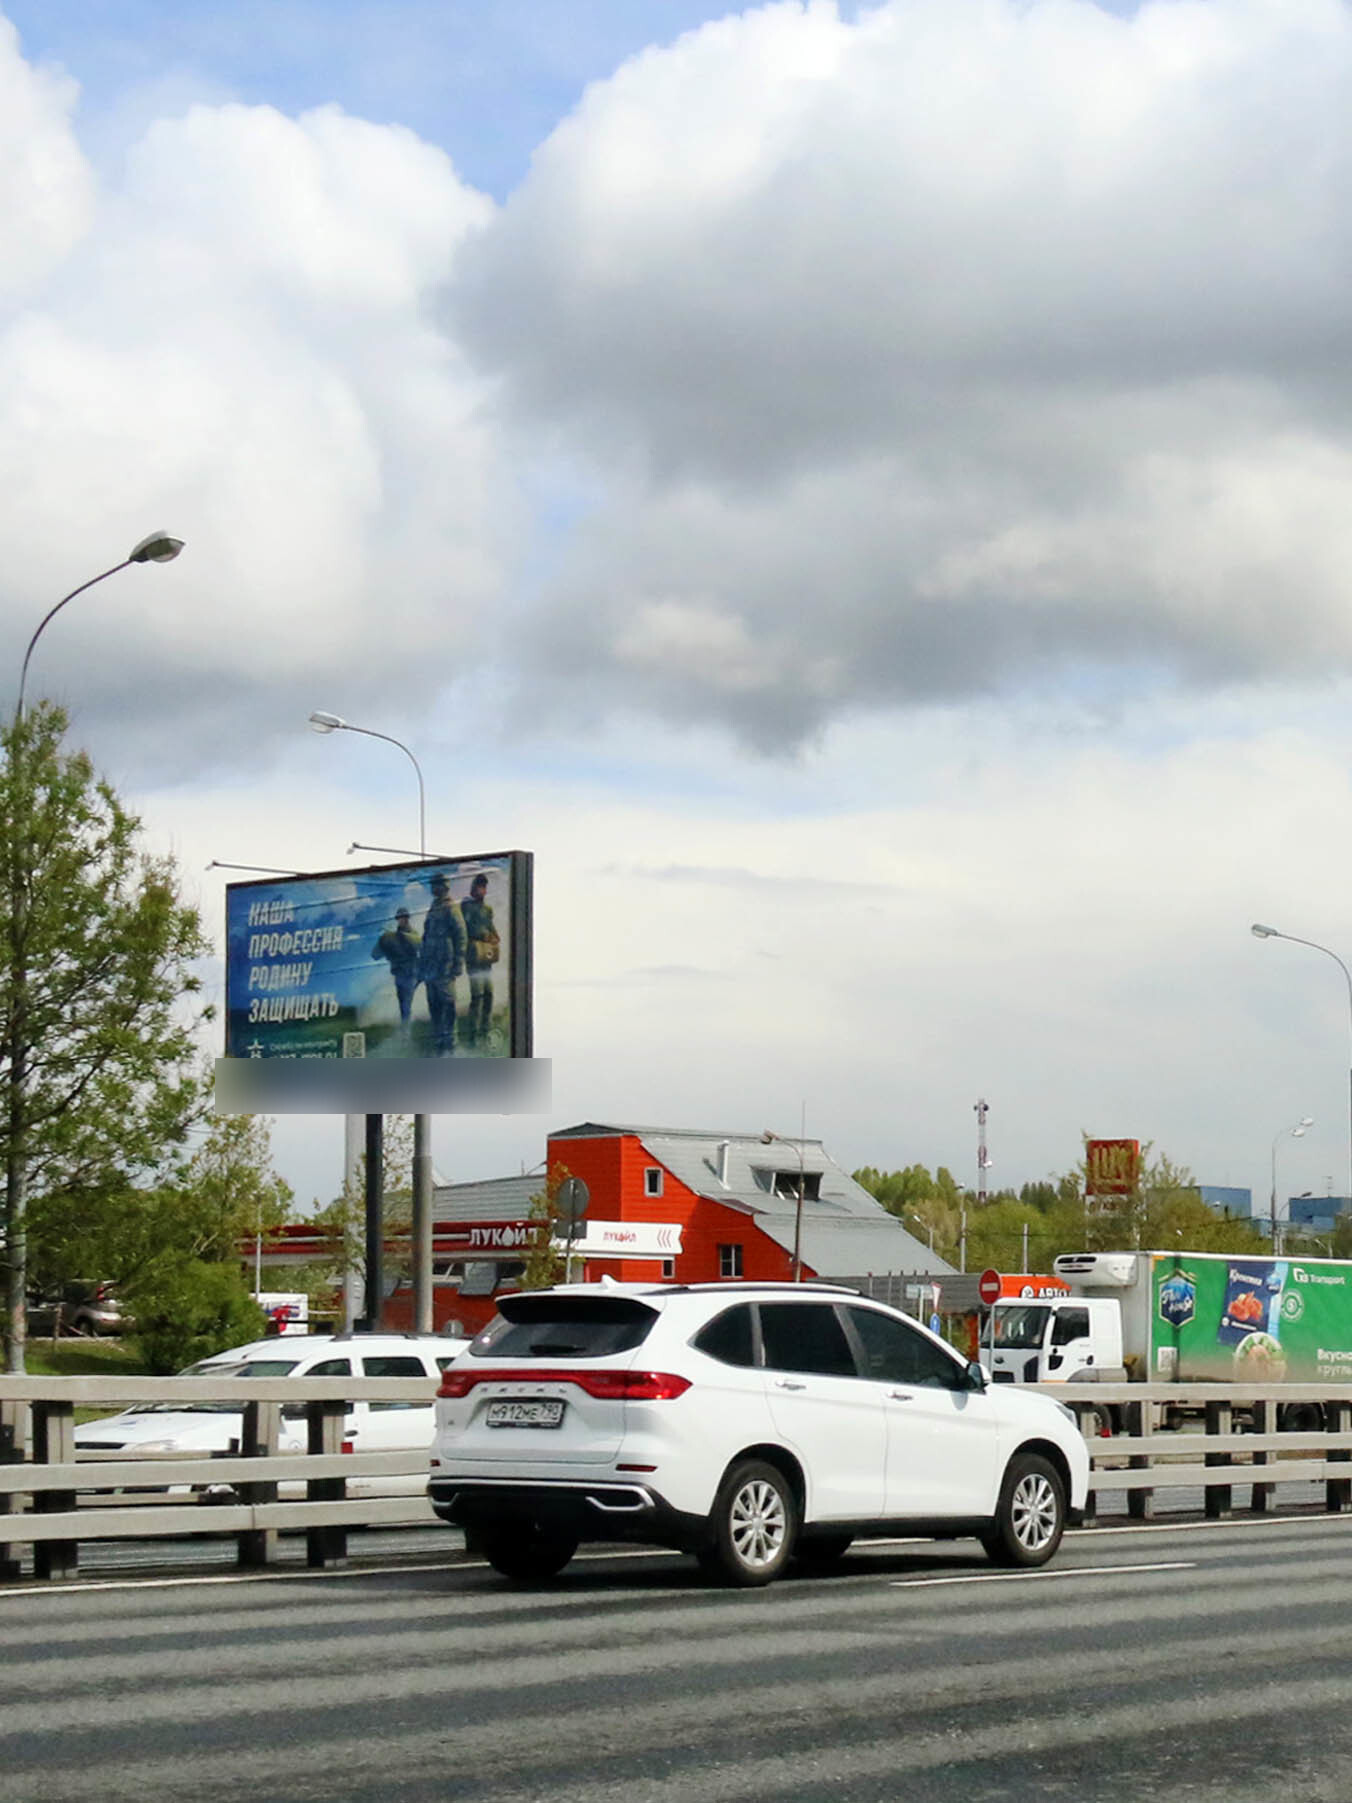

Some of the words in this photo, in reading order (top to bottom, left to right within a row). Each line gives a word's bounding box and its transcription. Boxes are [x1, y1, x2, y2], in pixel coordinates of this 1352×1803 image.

[248, 900, 295, 926] НАША
[248, 926, 344, 958] ПРОФЕССИЯ
[248, 962, 313, 990] РОДИНУ
[248, 993, 340, 1023] ЗАЩИЩАТЬ
